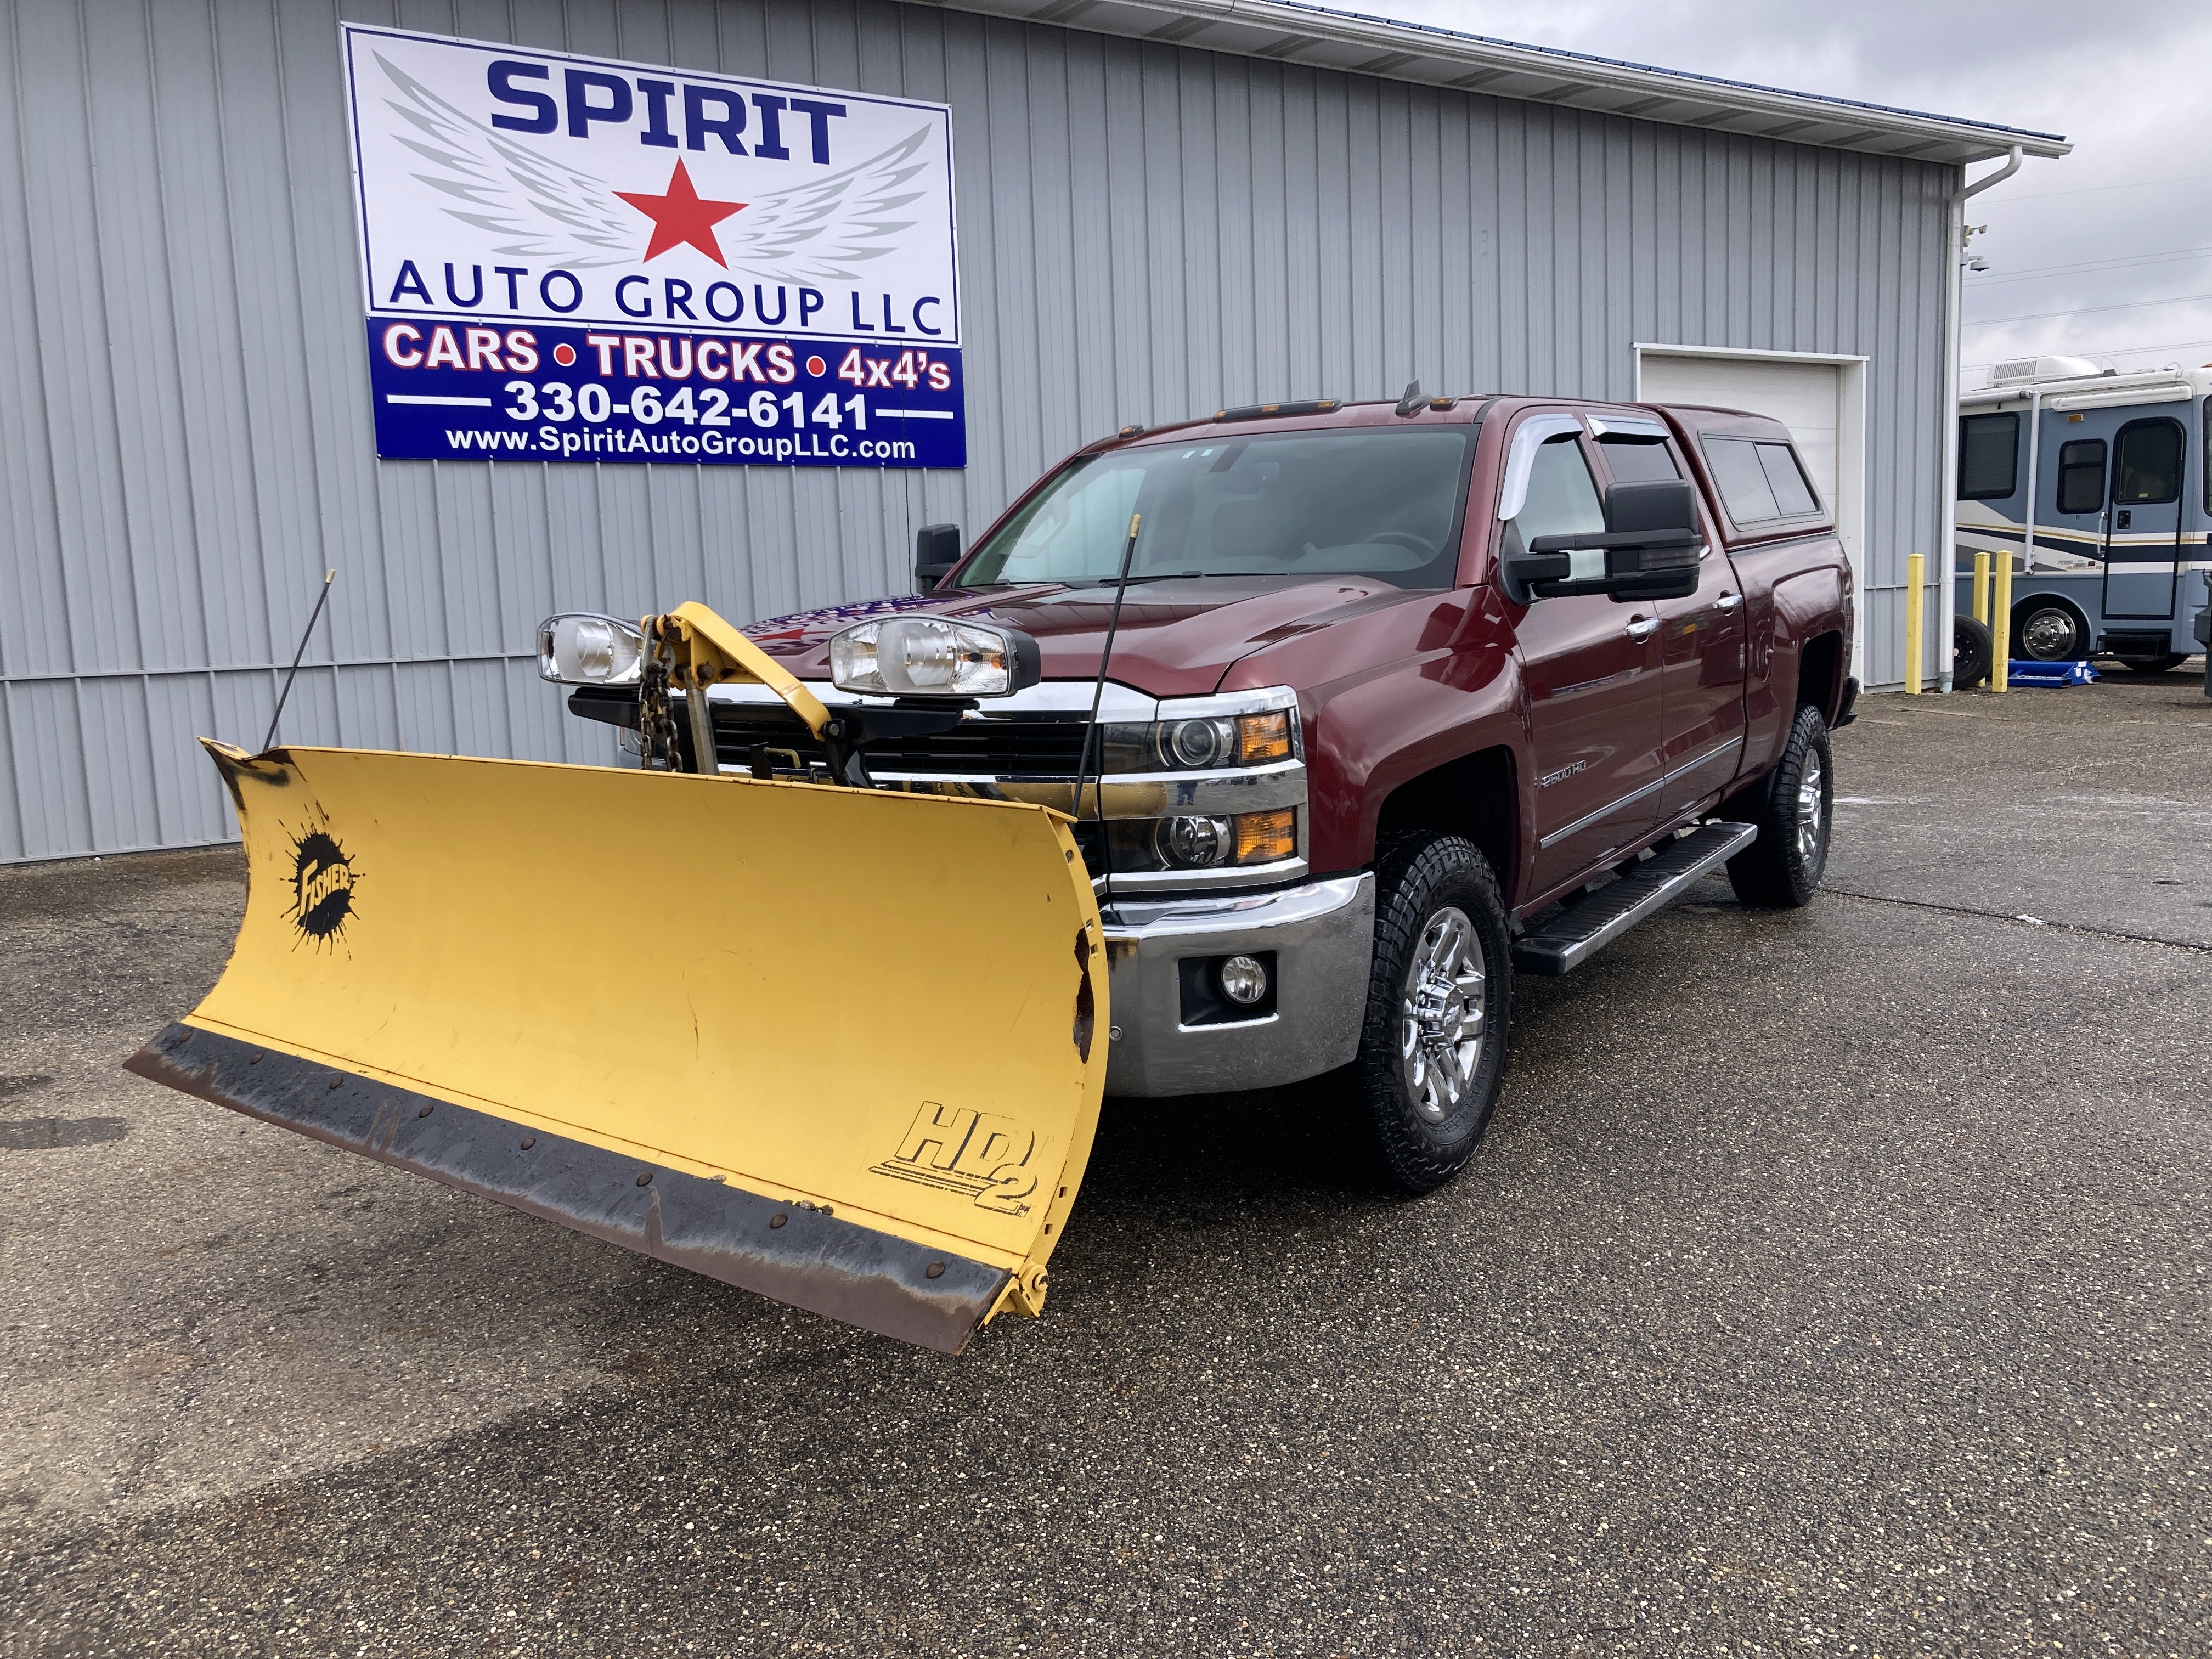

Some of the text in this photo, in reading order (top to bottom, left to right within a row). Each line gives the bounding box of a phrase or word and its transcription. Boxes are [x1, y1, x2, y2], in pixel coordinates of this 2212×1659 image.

[487, 60, 846, 165] SPIRIT
[389, 260, 942, 335] AUTO GROUP LLC
[384, 323, 952, 391] CARS TRUCKS 4x4's
[504, 381, 866, 430] 330-642-6141
[445, 426, 915, 461] www.SpiritAutoGroupLLC.com
[300, 859, 351, 918] FISHER
